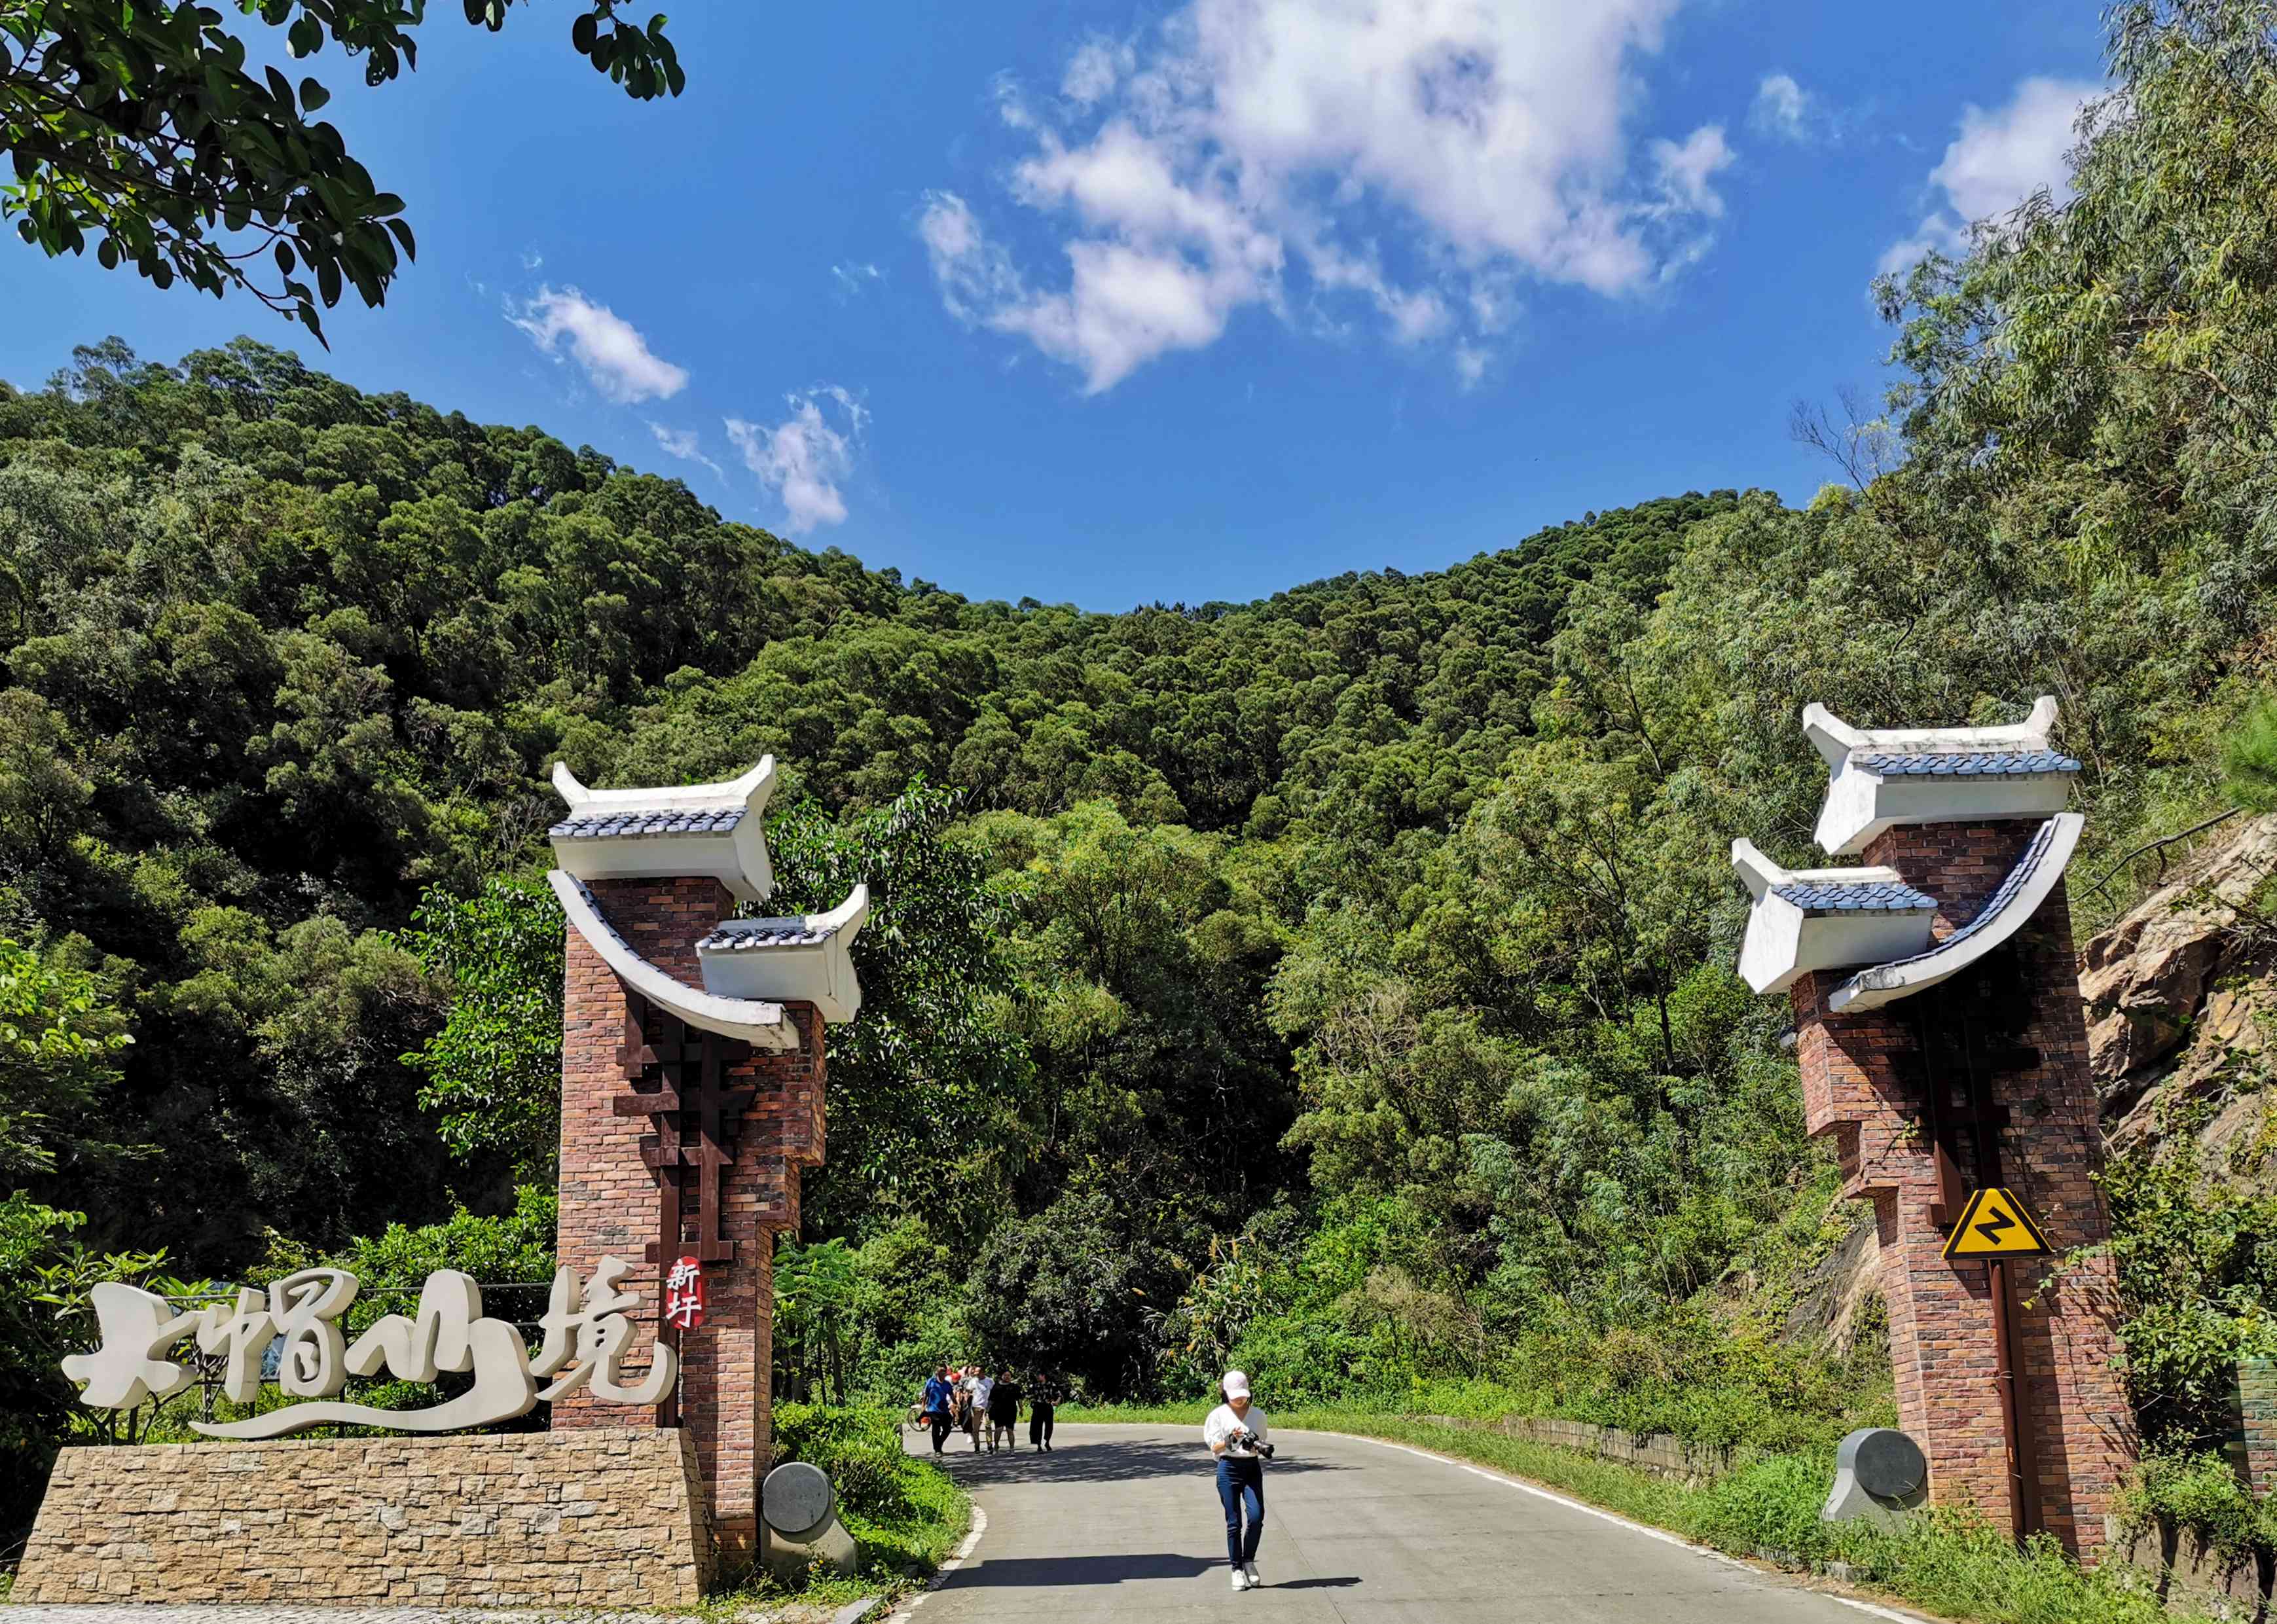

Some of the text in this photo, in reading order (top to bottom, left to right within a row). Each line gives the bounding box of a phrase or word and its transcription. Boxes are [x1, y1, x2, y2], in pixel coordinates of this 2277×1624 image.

[61, 1255, 678, 1439] 大帽山境
[666, 1258, 702, 1327] 新圩
